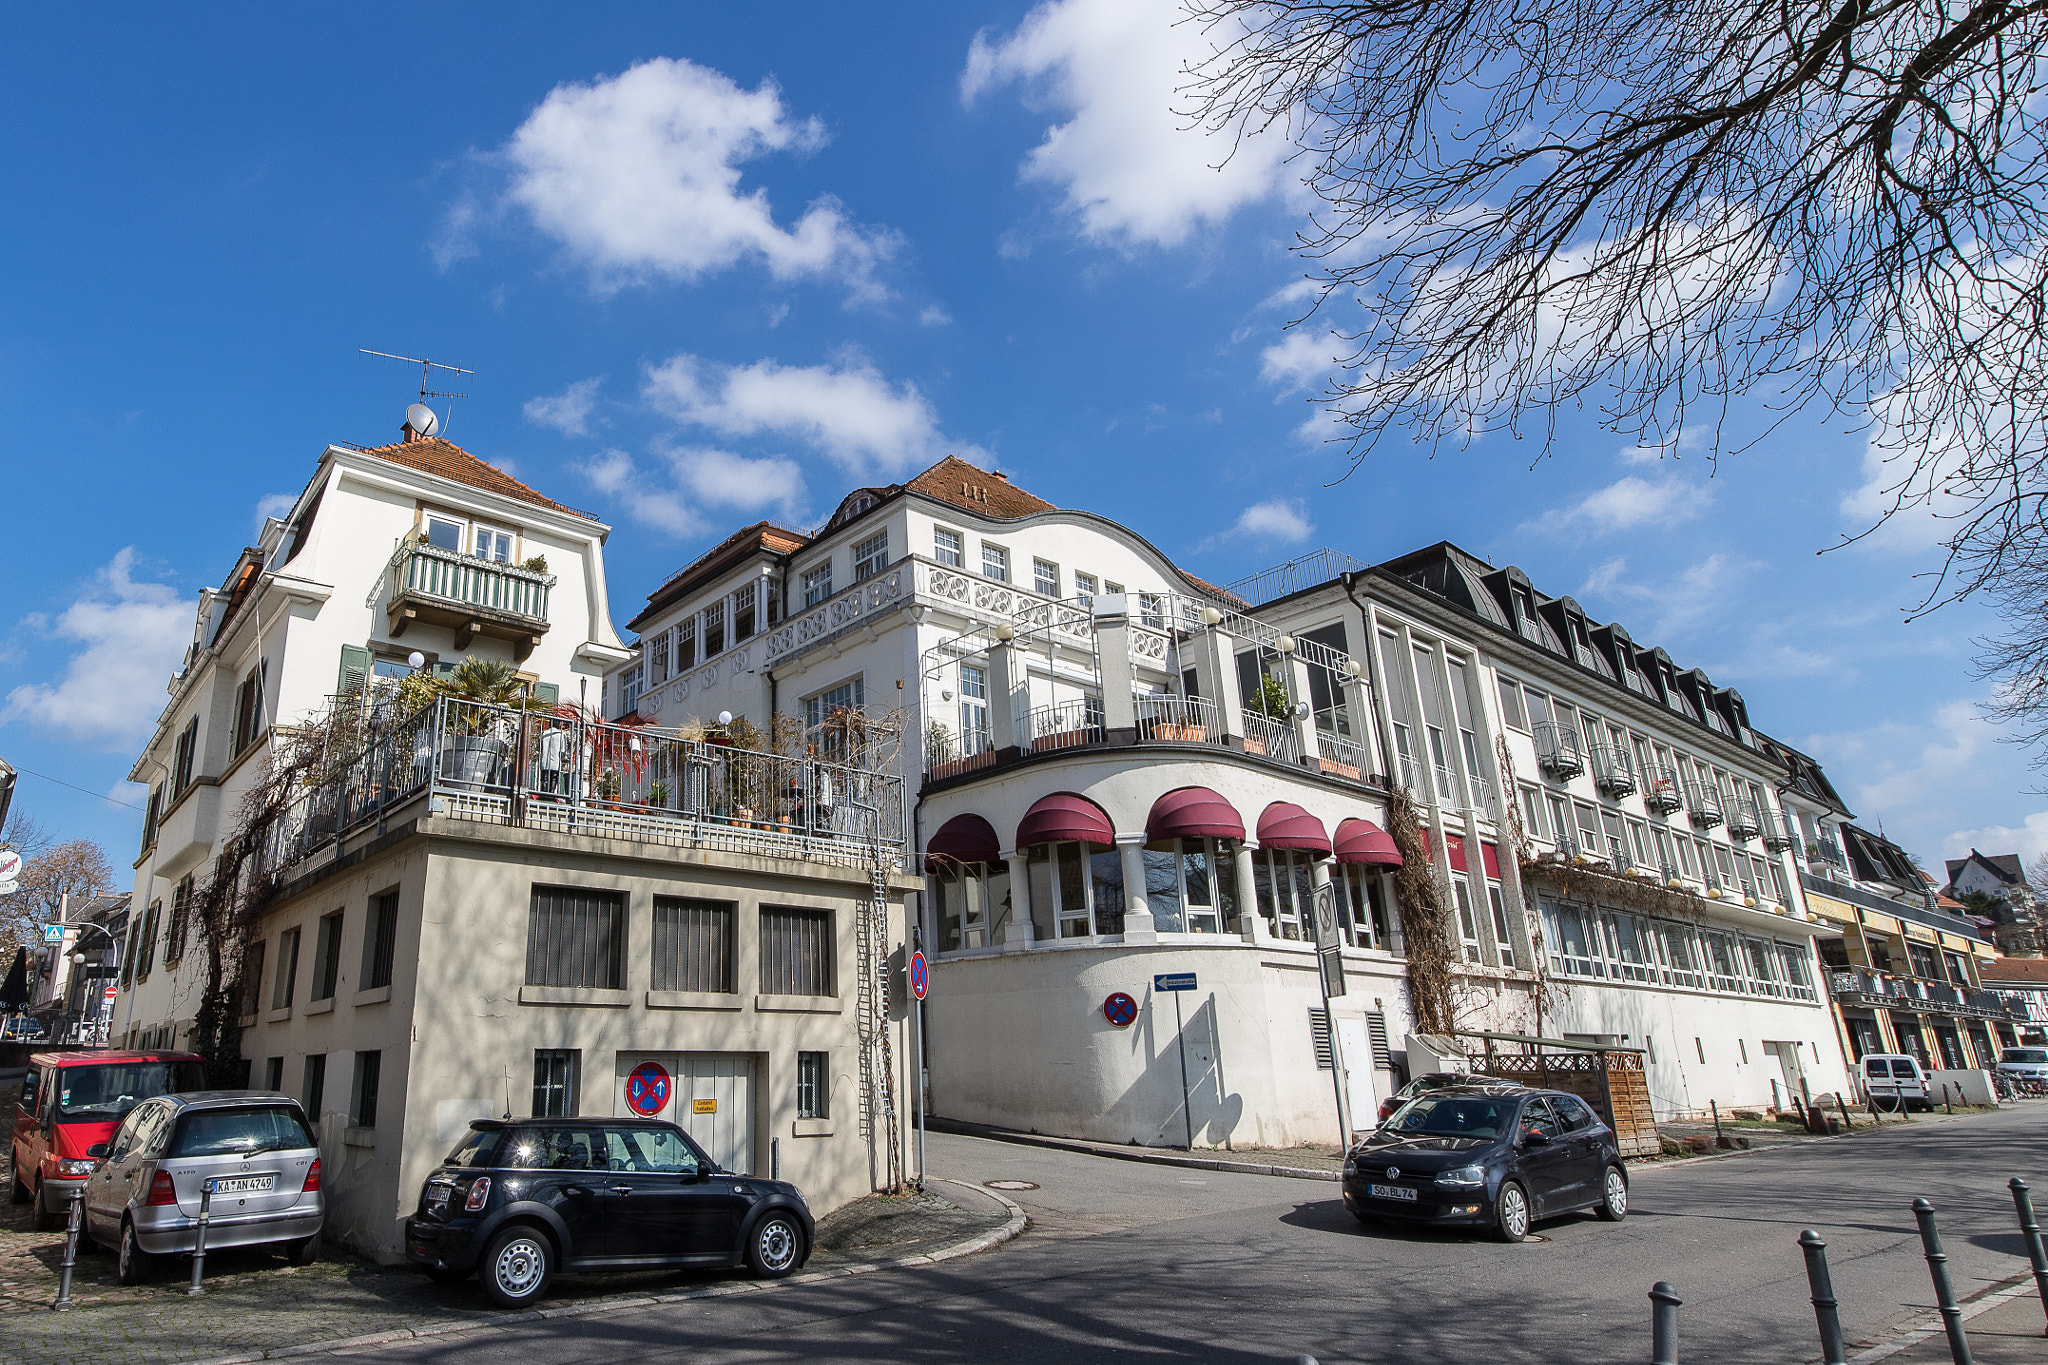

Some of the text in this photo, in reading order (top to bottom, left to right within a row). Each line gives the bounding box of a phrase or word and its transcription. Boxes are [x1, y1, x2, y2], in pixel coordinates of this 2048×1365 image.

[217, 1181, 230, 1192] KA
[236, 1180, 248, 1191] AN
[1374, 1185, 1414, 1199] SO BL 74
